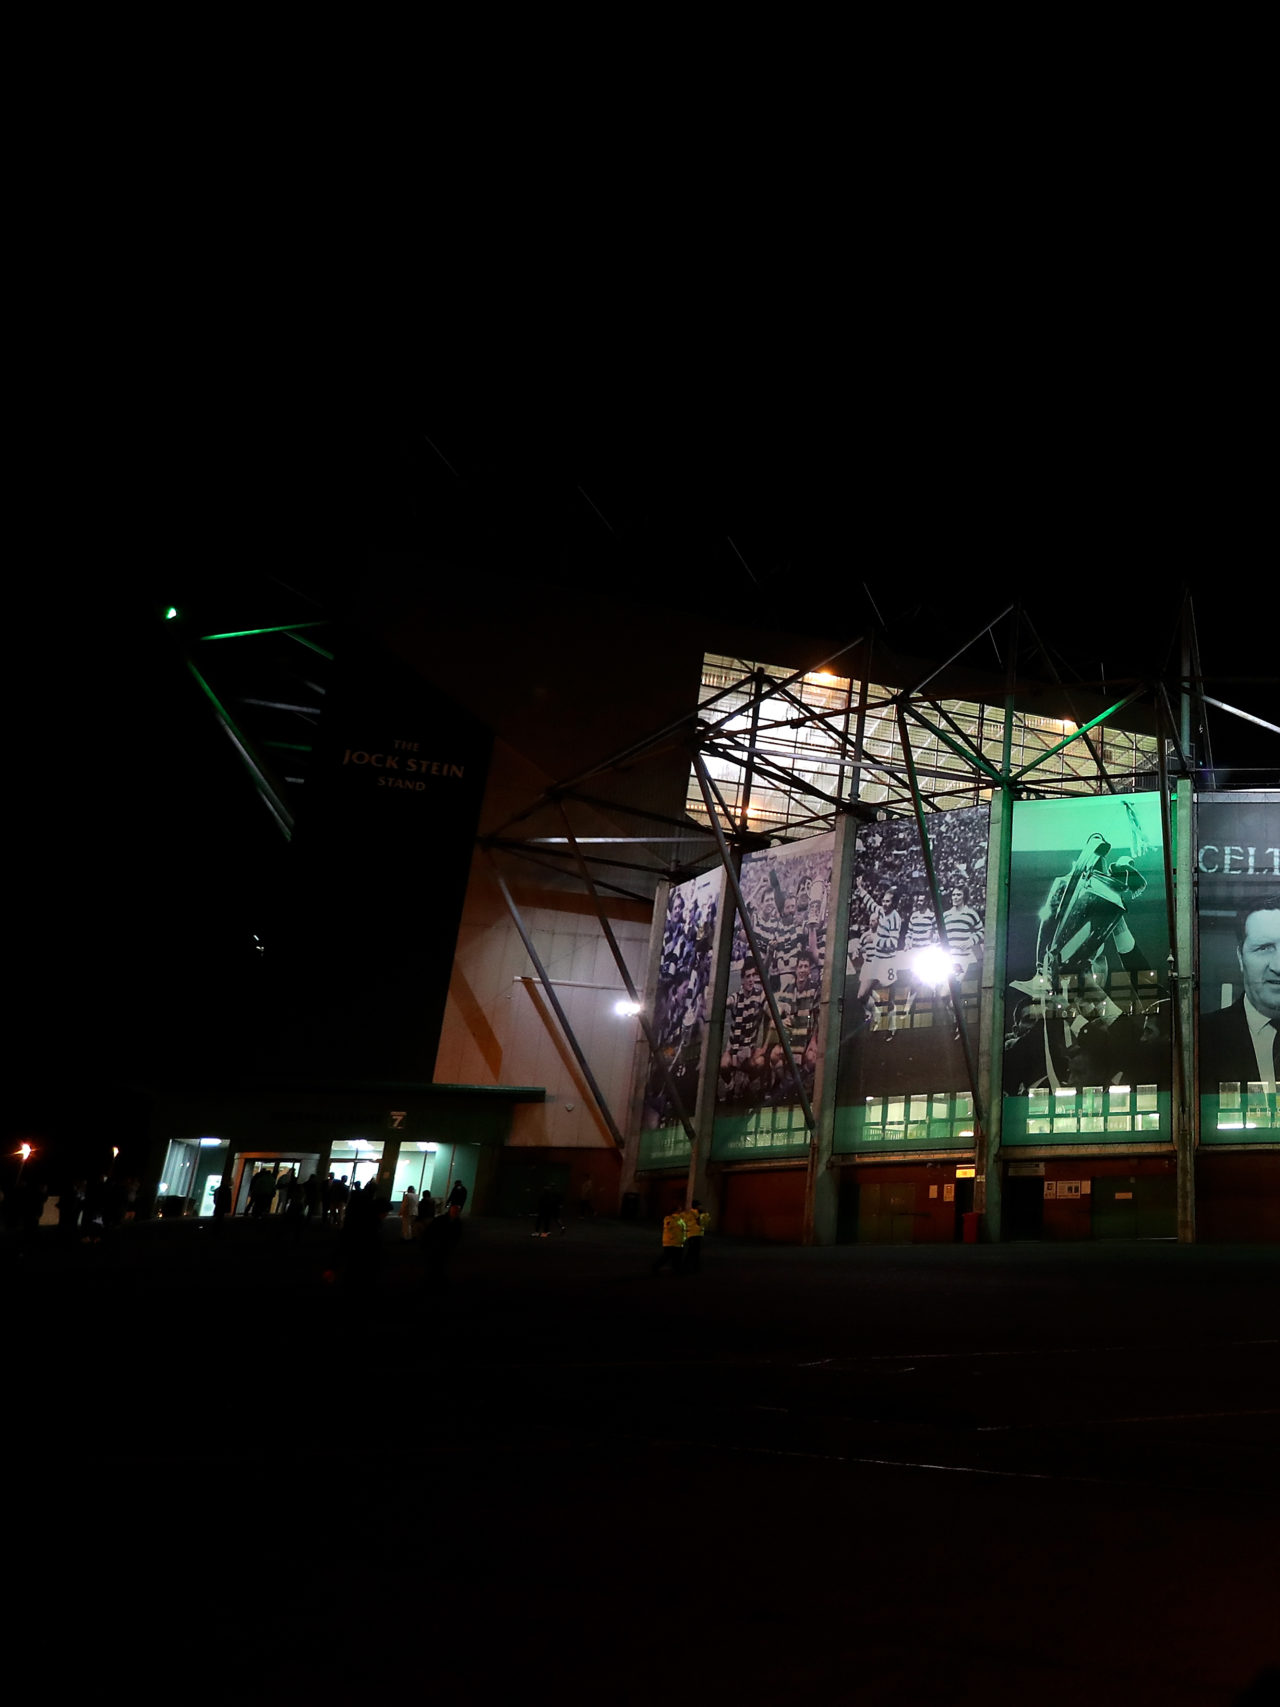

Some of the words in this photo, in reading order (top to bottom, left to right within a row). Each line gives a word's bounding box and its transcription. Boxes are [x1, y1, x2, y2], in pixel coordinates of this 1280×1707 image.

[392, 738, 421, 753] THE
[342, 748, 400, 770] JOCK
[405, 757, 465, 780] STEIN
[376, 775, 427, 792] STAND
[887, 968, 895, 981] 8
